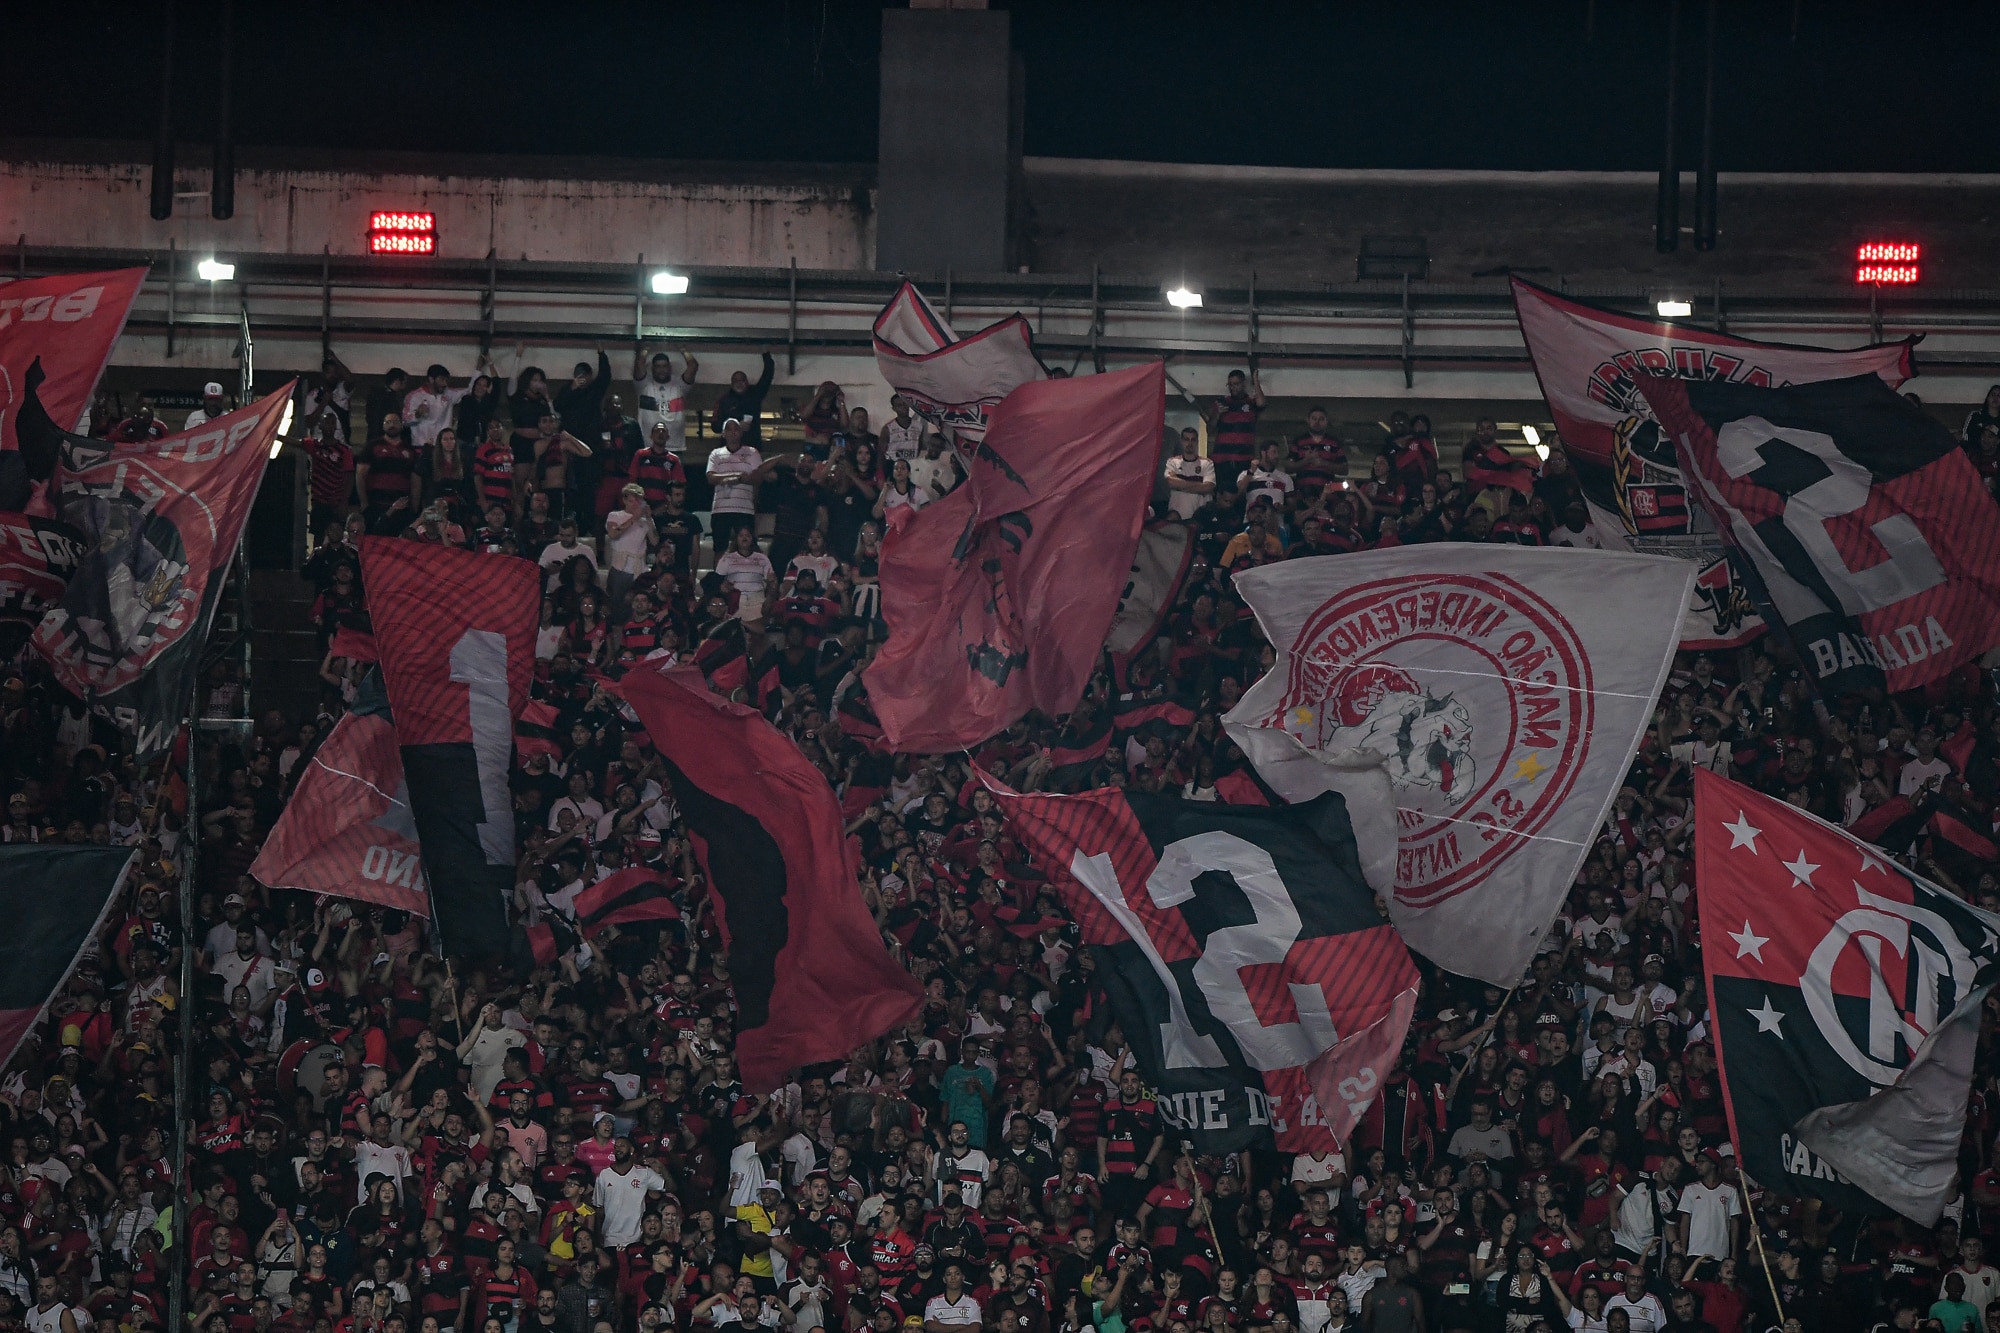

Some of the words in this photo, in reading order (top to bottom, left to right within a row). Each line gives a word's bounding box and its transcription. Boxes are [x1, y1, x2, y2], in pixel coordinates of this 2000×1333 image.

[1070, 830, 1338, 1072] 12
[1152, 1087, 1230, 1131] QUE
[1300, 1093, 1329, 1126] A
